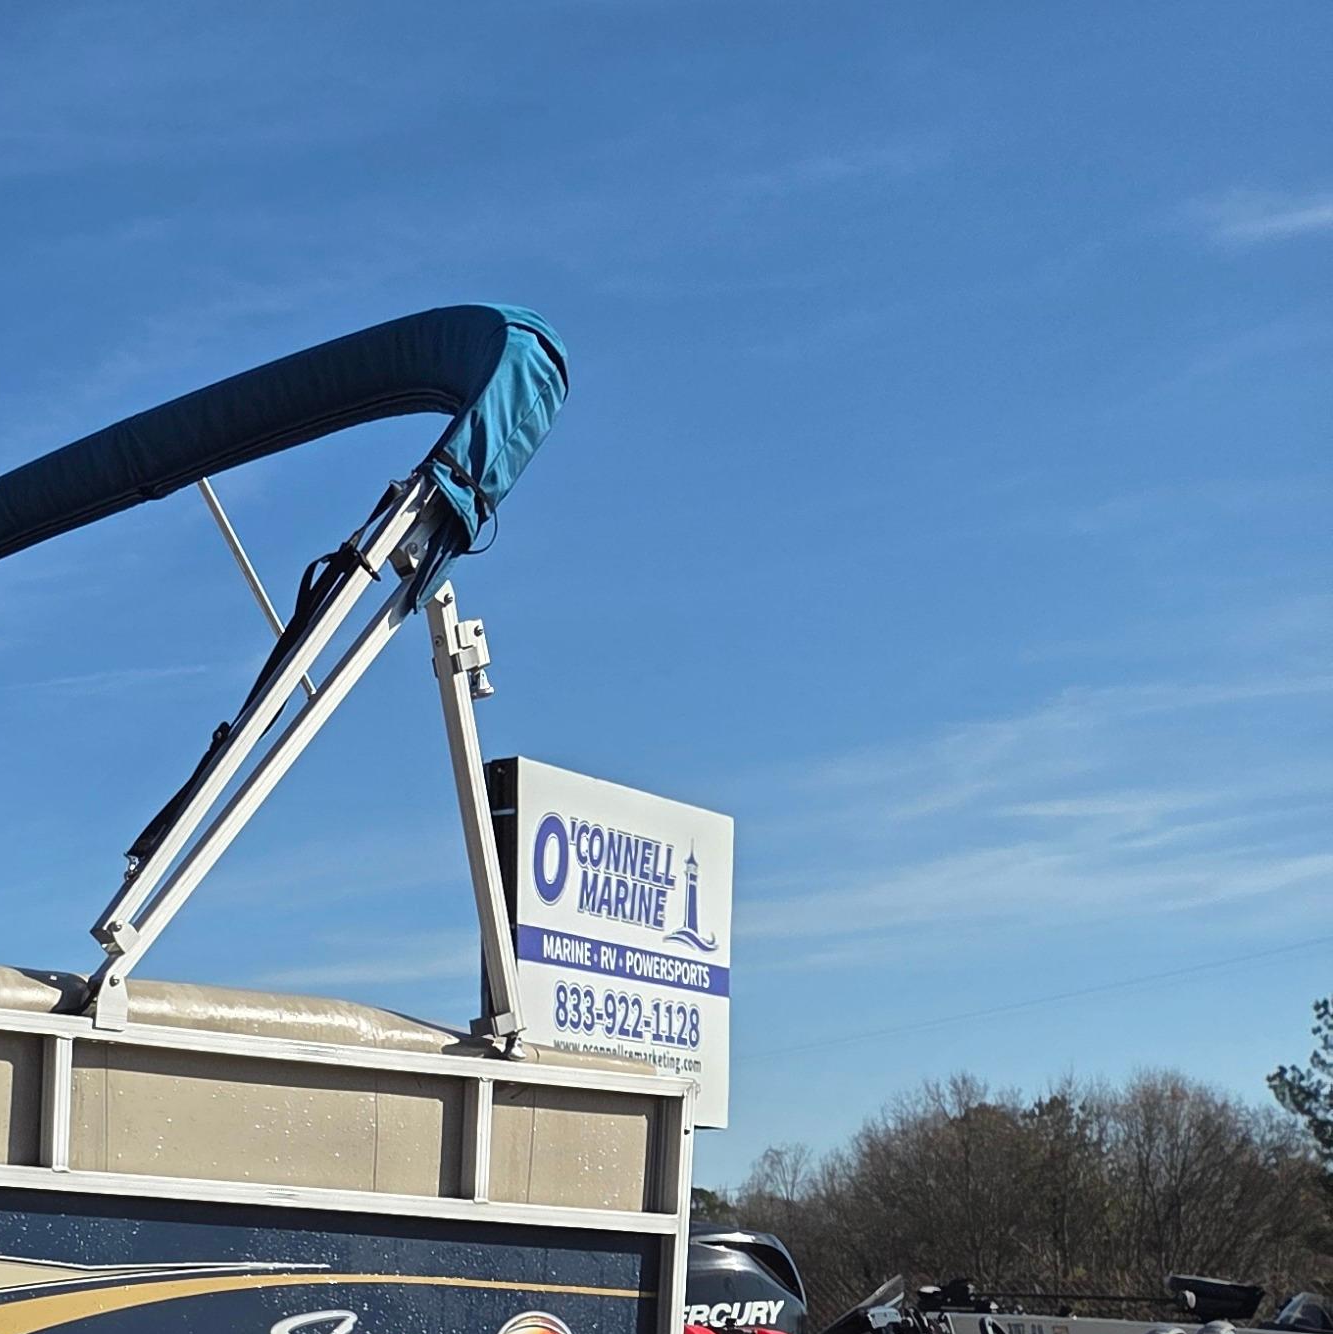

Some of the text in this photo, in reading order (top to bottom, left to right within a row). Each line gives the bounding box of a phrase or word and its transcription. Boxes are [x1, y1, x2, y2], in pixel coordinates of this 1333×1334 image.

[532, 811, 676, 905] O'CONNELL
[577, 868, 668, 931] MARINE
[542, 934, 711, 989] MARINE RV POWERSPORTS
[554, 980, 701, 1050] 833-922-1128
